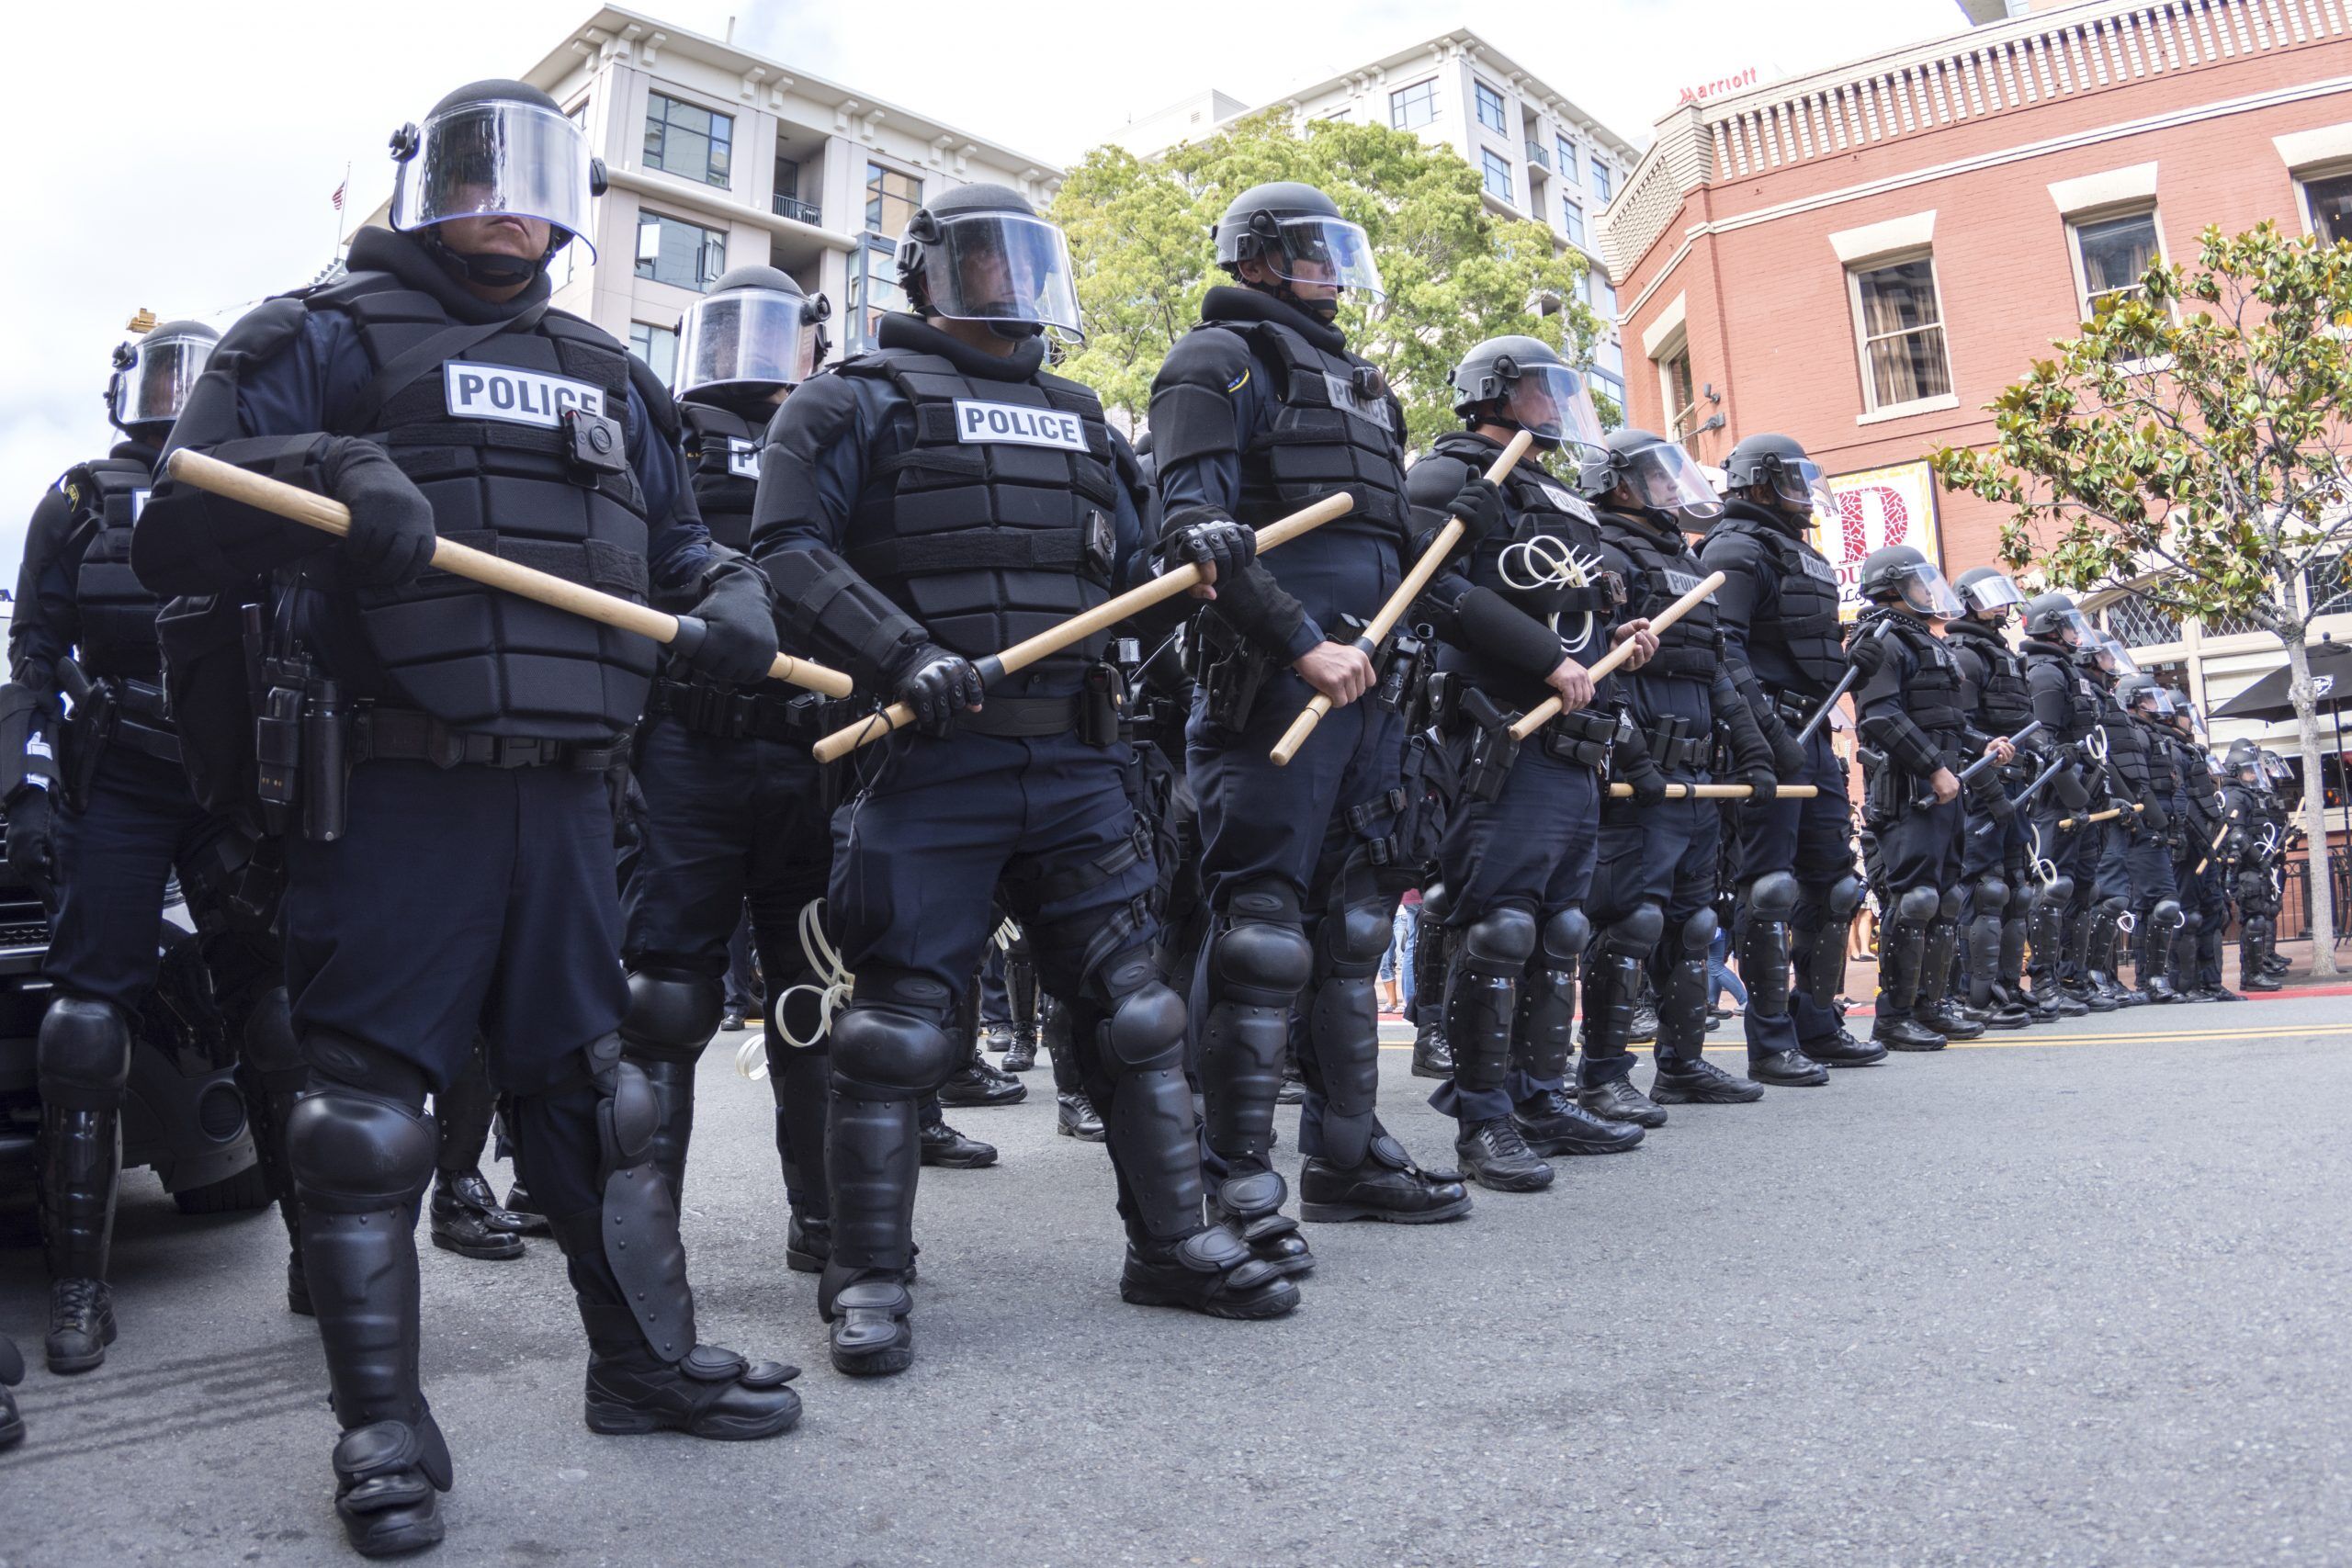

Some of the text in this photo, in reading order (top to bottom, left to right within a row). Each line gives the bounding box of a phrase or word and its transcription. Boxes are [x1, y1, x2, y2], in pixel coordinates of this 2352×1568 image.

[1677, 67, 1757, 106] Marriott
[965, 407, 1079, 444] POLICE
[1546, 489, 1595, 520] POLICE
